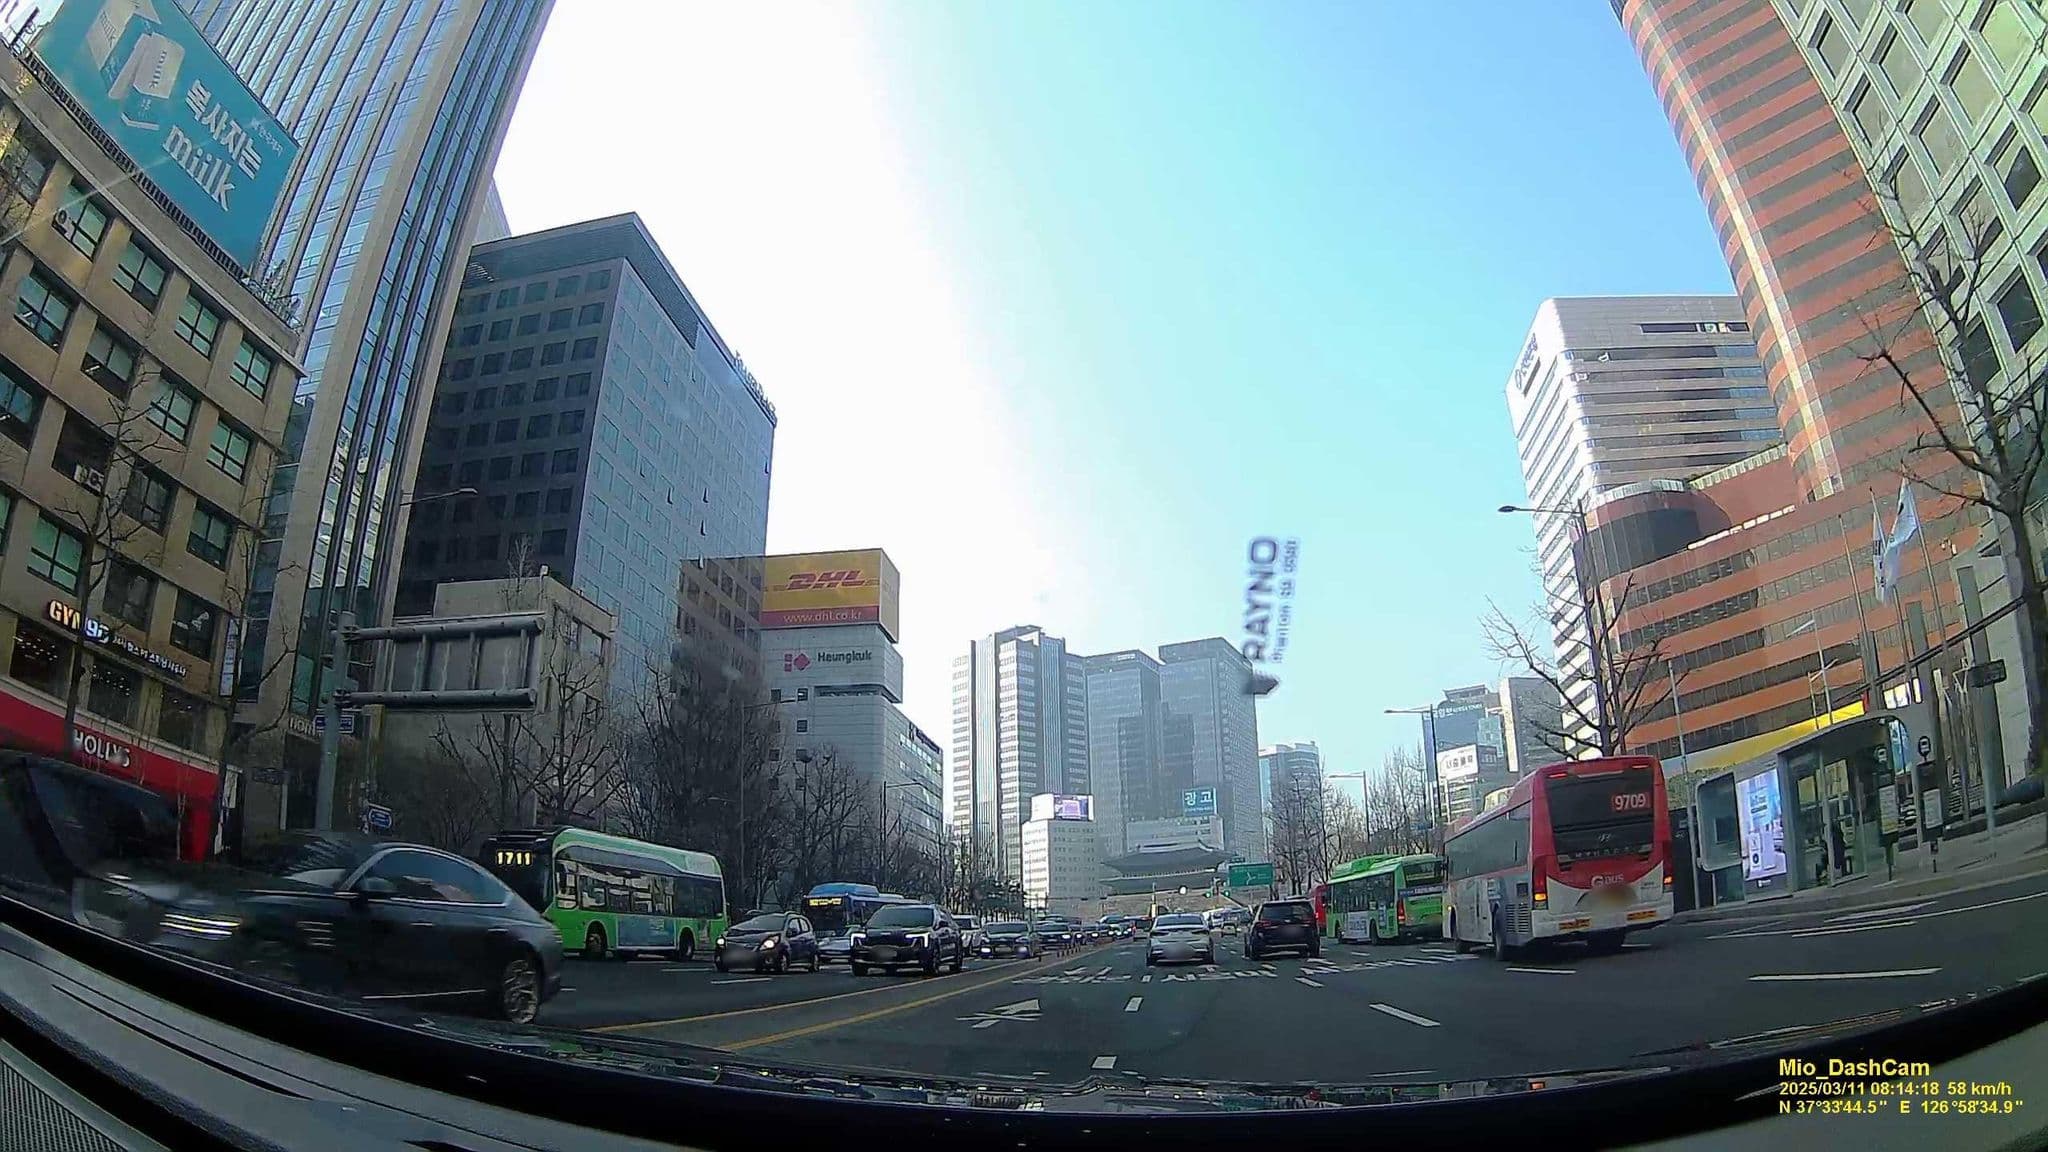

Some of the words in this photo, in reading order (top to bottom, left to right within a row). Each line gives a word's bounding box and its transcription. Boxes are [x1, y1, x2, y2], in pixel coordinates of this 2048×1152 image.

[185, 79, 262, 181] 복사지는
[162, 124, 236, 212] miilk
[788, 570, 865, 590] DHL
[1242, 537, 1278, 663] RAYNO
[783, 609, 863, 624] www.dhl.co.kr
[817, 650, 873, 665] Heungkuk
[1184, 791, 1213, 806] 광고
[1614, 793, 1647, 811] 9709
[496, 851, 532, 866] 1711
